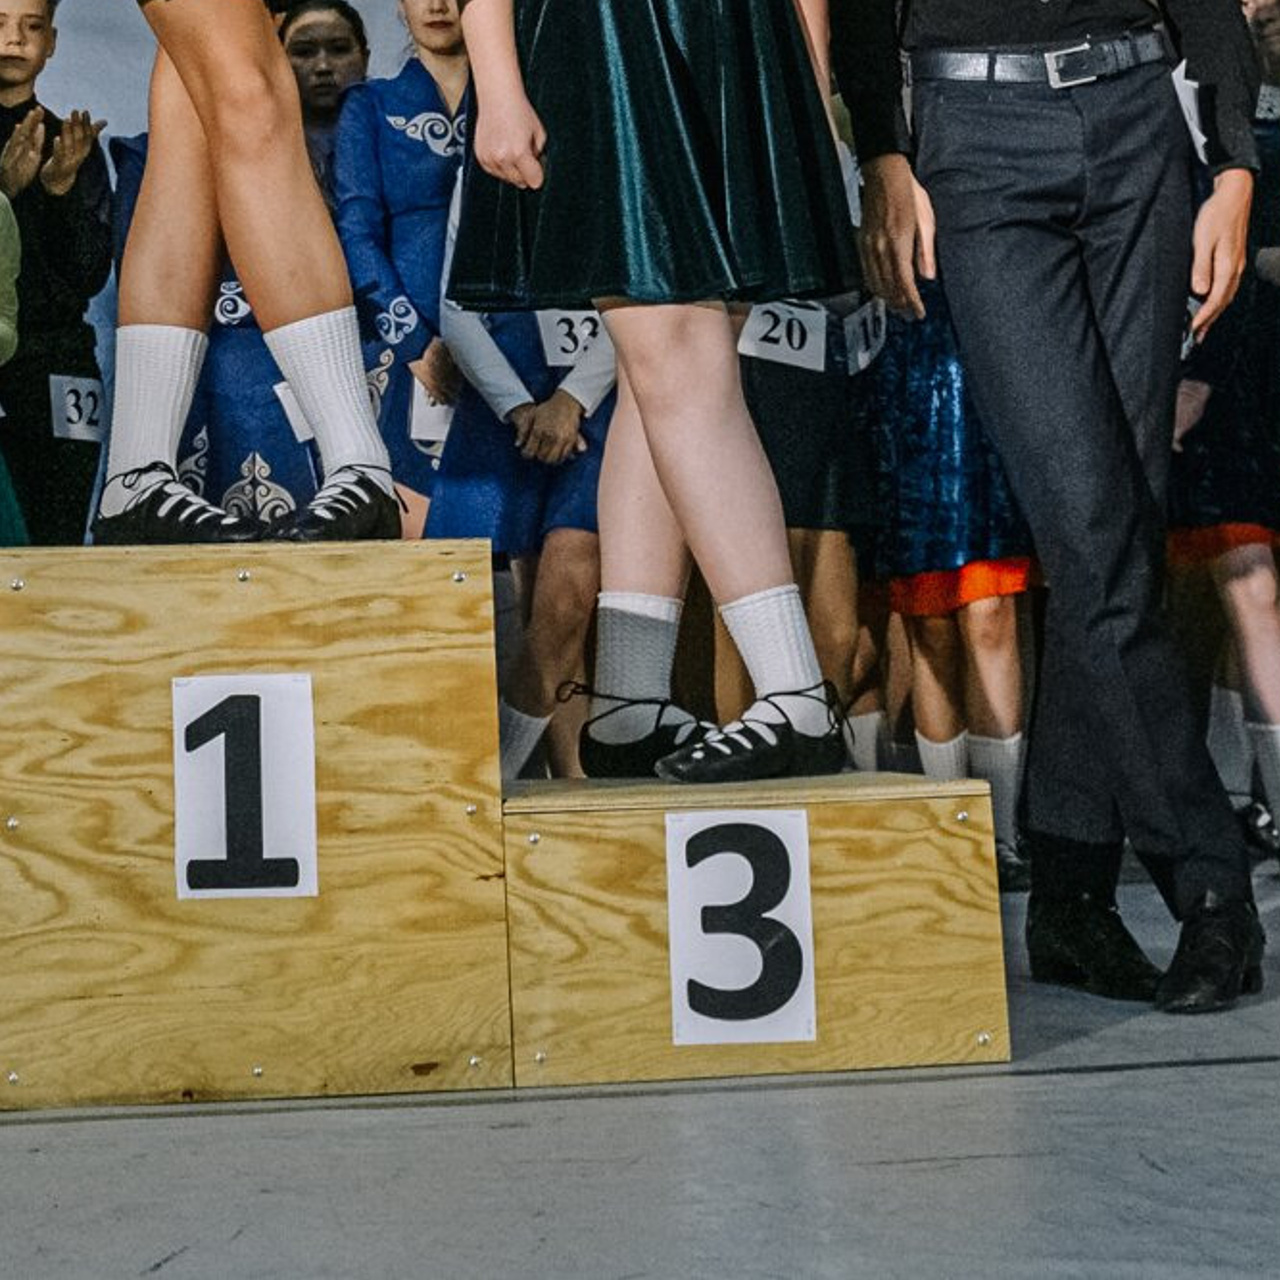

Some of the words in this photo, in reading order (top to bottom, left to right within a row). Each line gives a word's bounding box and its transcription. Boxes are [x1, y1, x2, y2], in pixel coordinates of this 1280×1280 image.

[758, 308, 808, 352] 20
[66, 388, 99, 426] 32
[184, 694, 300, 891] 1
[685, 822, 804, 1022] 3
